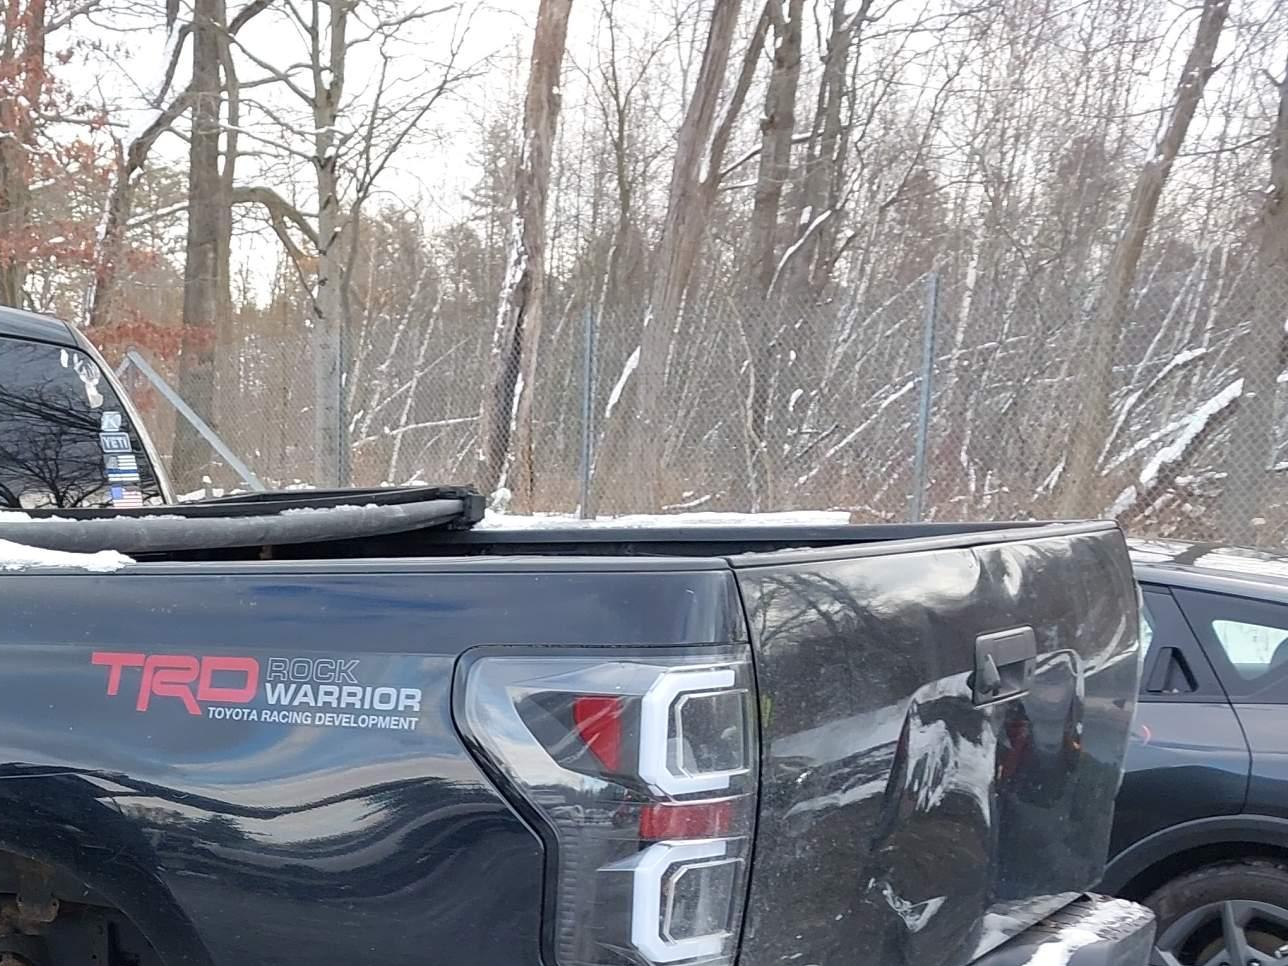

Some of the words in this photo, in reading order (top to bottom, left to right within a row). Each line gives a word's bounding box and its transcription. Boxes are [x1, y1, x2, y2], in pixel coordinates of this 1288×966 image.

[103, 436, 128, 449] YETI
[266, 657, 360, 683] ROCK
[92, 652, 260, 715] TRD
[265, 683, 422, 712] WARRIOR
[208, 706, 258, 722] TOYOTA
[261, 710, 312, 725] RACING
[314, 712, 419, 730] DEVELOPMENT
